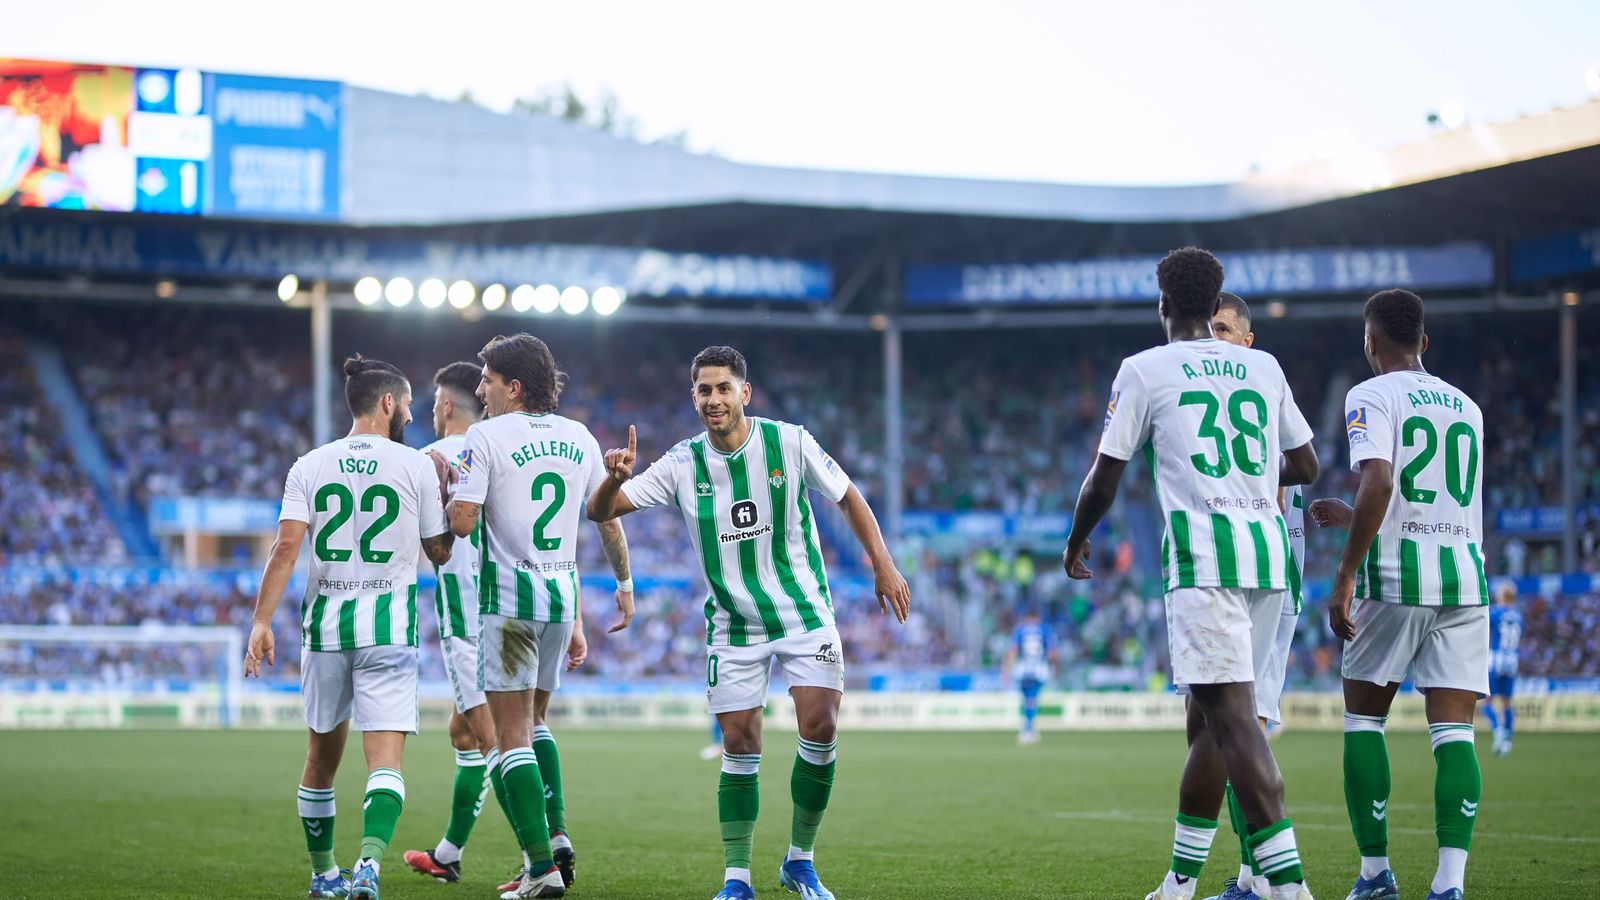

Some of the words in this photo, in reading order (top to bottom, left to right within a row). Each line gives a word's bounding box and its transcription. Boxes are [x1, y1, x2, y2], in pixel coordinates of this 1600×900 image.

[1182, 359, 1247, 380] A.DIAO
[1408, 390, 1463, 413] ABNER
[1178, 388, 1268, 479] 38
[338, 458, 378, 475] ISCO
[511, 440, 584, 468] BELLERÍN
[1400, 416, 1478, 507] 20
[315, 483, 400, 563] 22
[531, 472, 566, 551] 2
[720, 524, 771, 543] finetwork
[362, 580, 393, 590] GREEN
